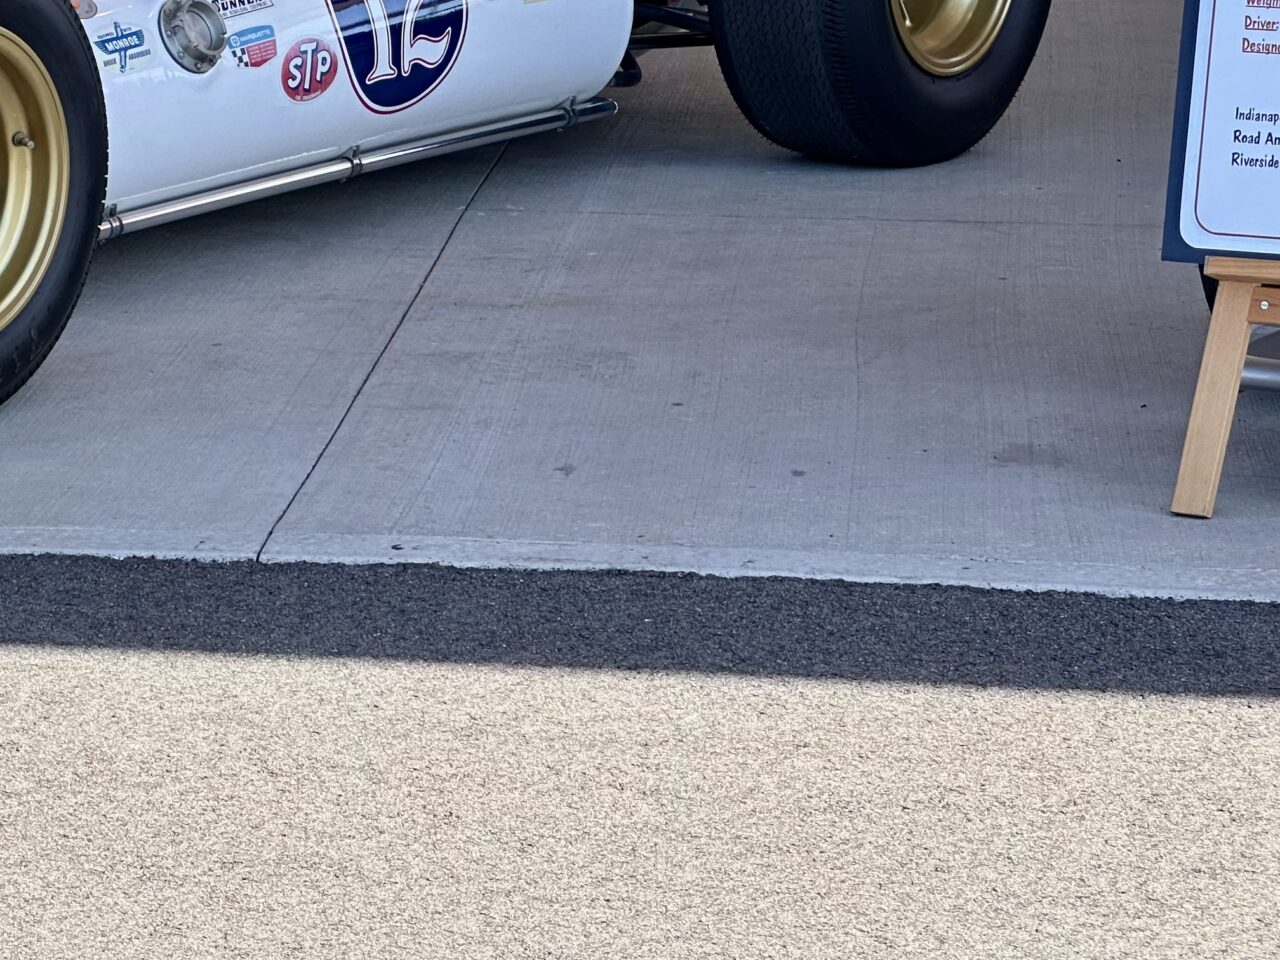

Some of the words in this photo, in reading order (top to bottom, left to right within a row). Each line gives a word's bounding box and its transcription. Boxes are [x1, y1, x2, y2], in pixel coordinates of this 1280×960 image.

[1244, 16, 1280, 31] Driver:
[104, 35, 140, 52] MONROE
[287, 42, 331, 90] STP
[1233, 130, 1261, 146] Road
[1231, 152, 1280, 169] Riverside
